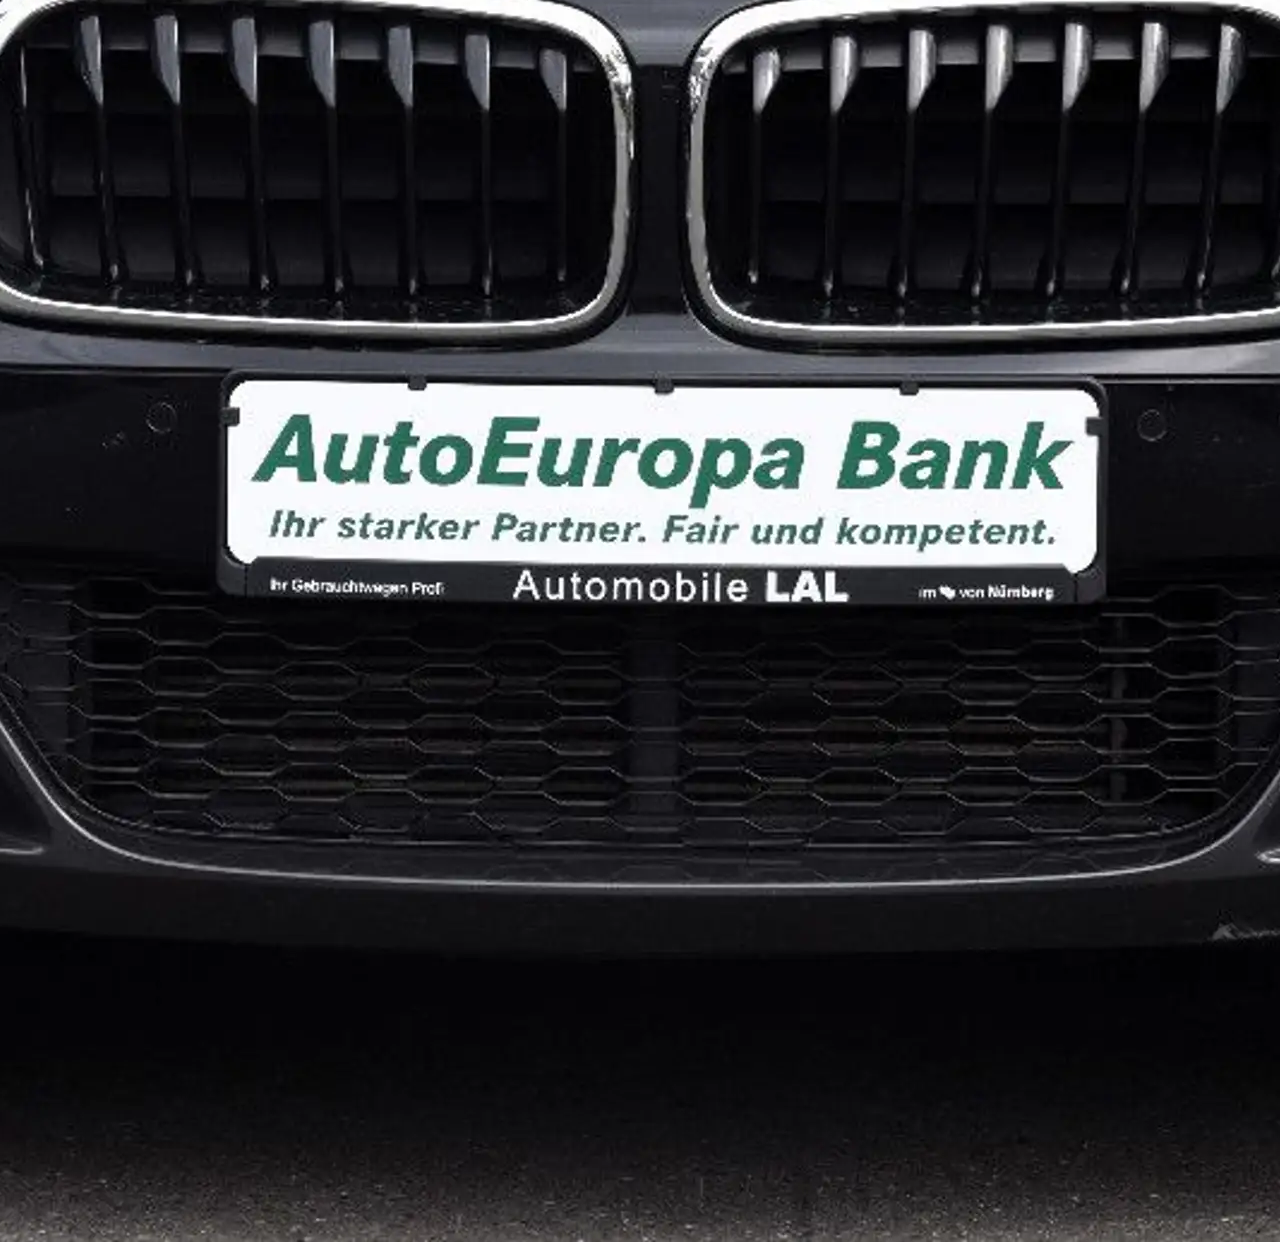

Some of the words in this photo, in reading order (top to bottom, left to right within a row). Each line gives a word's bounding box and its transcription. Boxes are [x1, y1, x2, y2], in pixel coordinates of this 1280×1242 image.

[251, 413, 805, 509] AutoEuropa
[837, 420, 1074, 490] Bank
[269, 509, 325, 538] Ihr
[337, 512, 480, 542] starker
[491, 514, 646, 543] Partner.
[662, 515, 739, 545] Fair
[751, 517, 824, 545] und
[836, 517, 1056, 552] kompetent.
[270, 578, 288, 592] Ihr
[512, 569, 749, 602] Automobile
[765, 570, 849, 603] LAL
[959, 588, 985, 599] von
